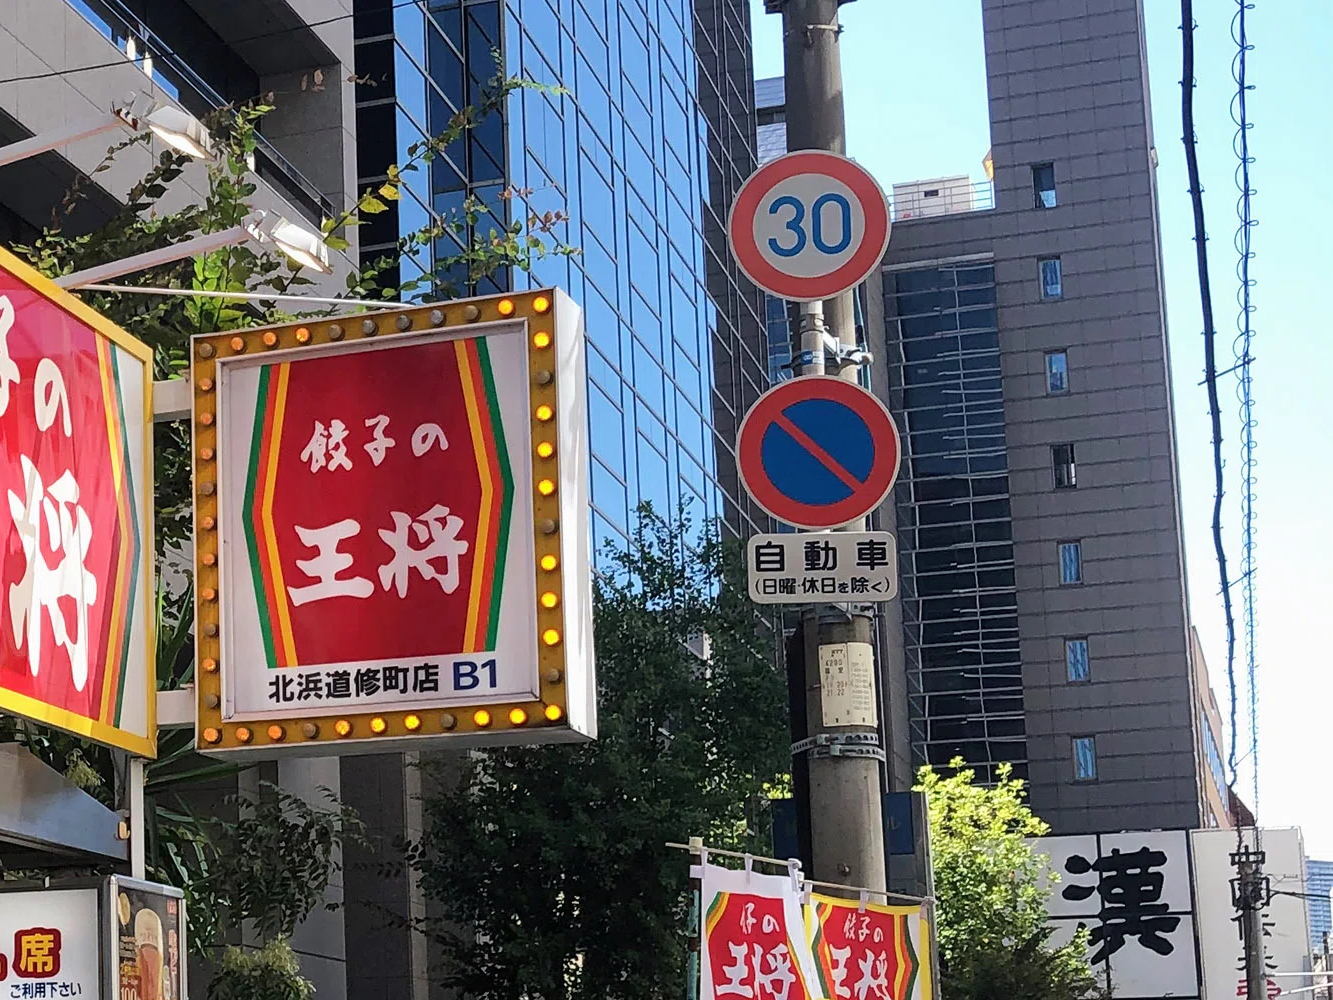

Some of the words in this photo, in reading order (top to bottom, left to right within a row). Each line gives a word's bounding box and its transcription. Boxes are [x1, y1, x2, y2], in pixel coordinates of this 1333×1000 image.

[768, 192, 852, 258] 30
[300, 413, 449, 474] 餃子の
[287, 503, 469, 607] 王将
[755, 538, 889, 573] 自動車
[268, 663, 440, 703] 北浜道修町店
[452, 658, 499, 692] B1
[739, 902, 780, 935] 子の
[1062, 846, 1181, 966] 漢
[16, 930, 59, 976] 席
[10, 982, 82, 999] ご利用下さい
